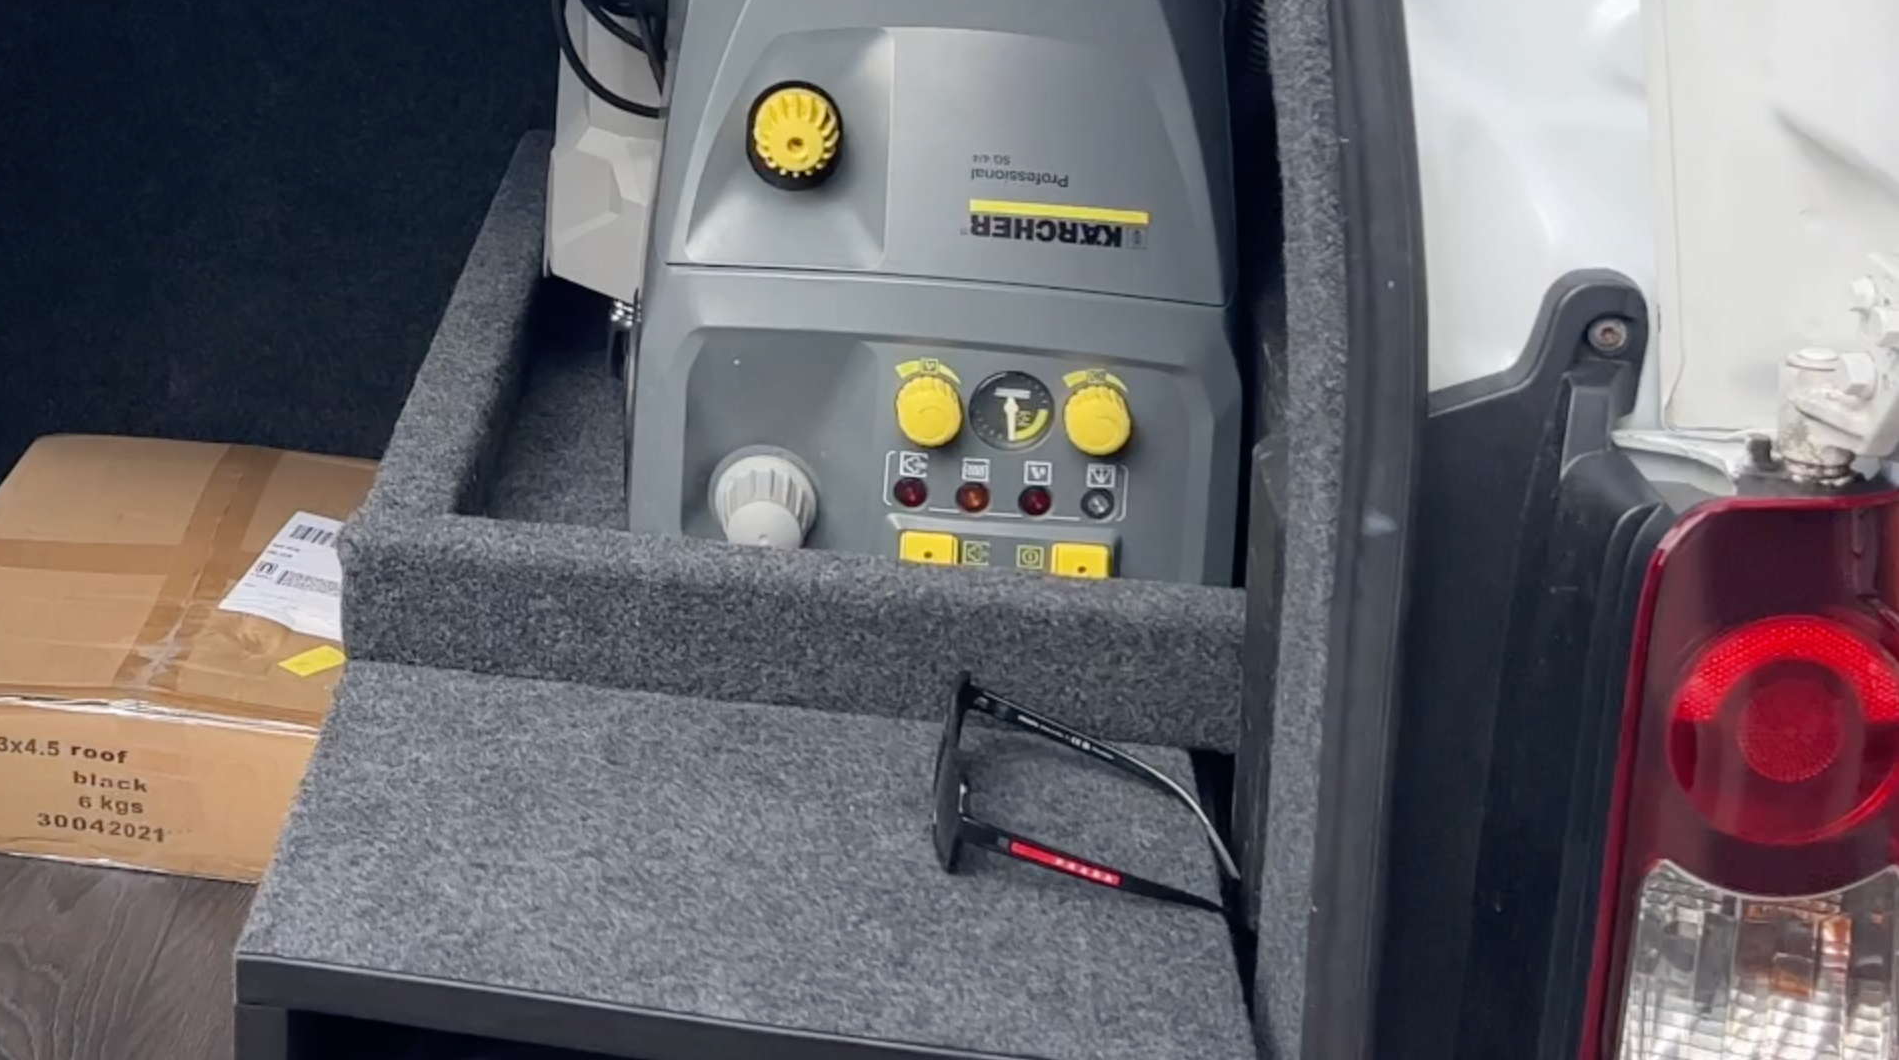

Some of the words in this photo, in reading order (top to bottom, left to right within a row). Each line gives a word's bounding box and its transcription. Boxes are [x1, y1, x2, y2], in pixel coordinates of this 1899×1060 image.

[971, 168, 1069, 188] Professional
[970, 214, 1123, 248] KÄRCHER
[71, 746, 128, 764] roof
[73, 771, 148, 793] black
[78, 795, 92, 809] 6
[101, 795, 144, 816] kgs
[37, 812, 165, 843] 30042021
